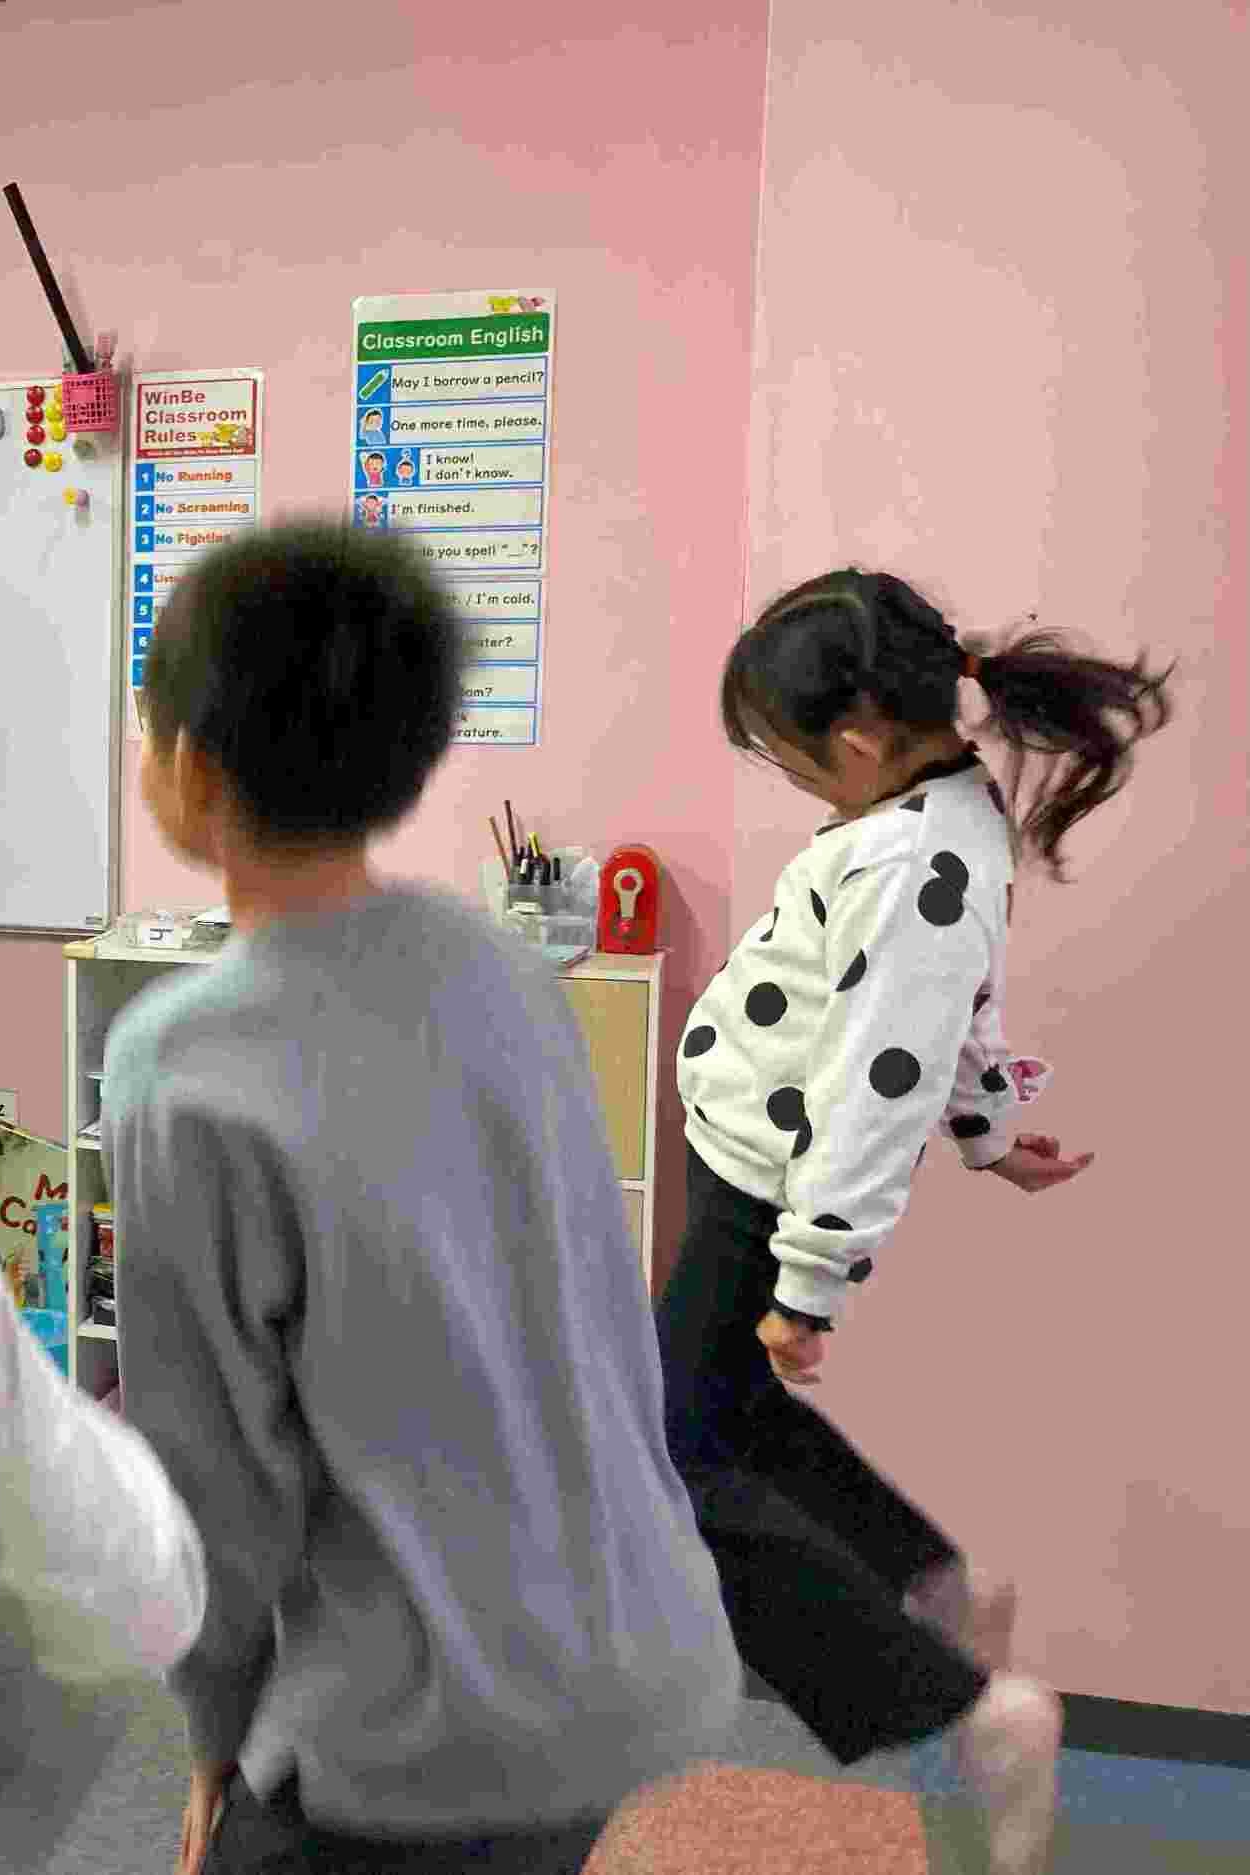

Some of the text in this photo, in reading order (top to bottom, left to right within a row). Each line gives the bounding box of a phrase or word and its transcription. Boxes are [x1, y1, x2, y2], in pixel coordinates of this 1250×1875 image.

[362, 325, 544, 351] Classroom English
[392, 371, 544, 391] May I borrow a pencil?
[144, 389, 206, 406] WinBe
[145, 408, 247, 425] Classroom
[390, 420, 417, 432] One
[420, 420, 453, 431] more
[494, 416, 543, 430] please.
[144, 429, 197, 444] Rules
[426, 452, 475, 465] I know!
[141, 469, 232, 483] 1 No Running
[426, 467, 514, 480] I don't know.
[141, 501, 249, 514] 2 No Screaming
[391, 502, 475, 515] I'm finished.
[141, 534, 149, 545] 3
[156, 534, 174, 545] No
[437, 547, 462, 559] you
[465, 544, 495, 558] spell
[139, 573, 149, 585] 4
[476, 592, 499, 604] I'm
[503, 592, 535, 605] cold.
[139, 605, 148, 616] 5
[138, 636, 148, 648] 6
[34, 1173, 69, 1201] M
[0, 1196, 38, 1236] Co
